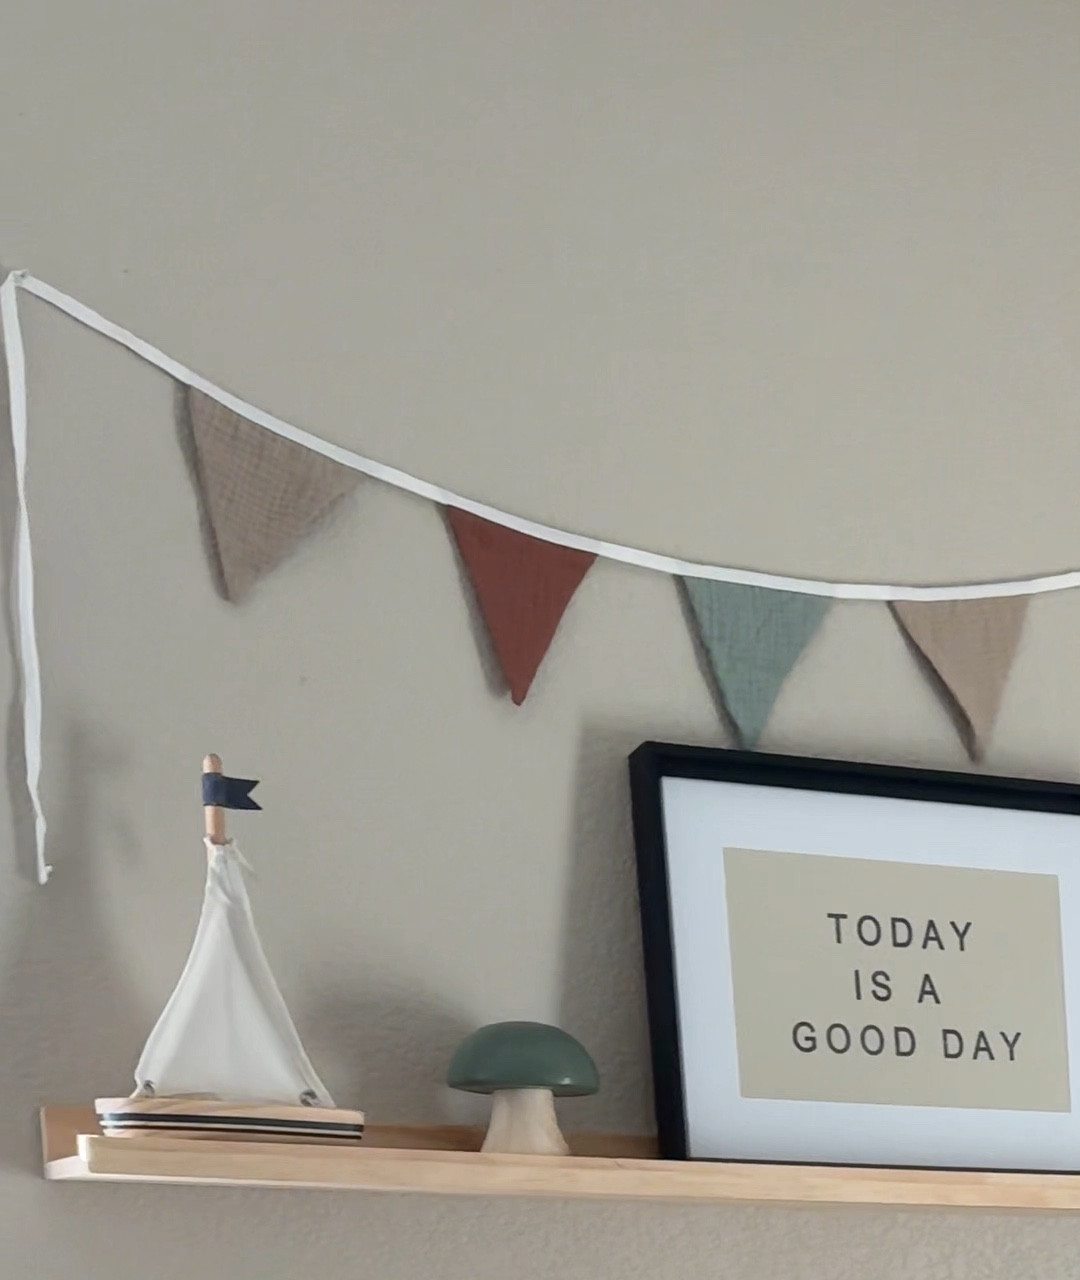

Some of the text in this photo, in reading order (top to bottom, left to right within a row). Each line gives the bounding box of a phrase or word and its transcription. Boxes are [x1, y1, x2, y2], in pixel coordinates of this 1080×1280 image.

[826, 912, 972, 952] TODAY
[854, 969, 941, 1005] IS A
[792, 1021, 1022, 1061] GOOD DAY
